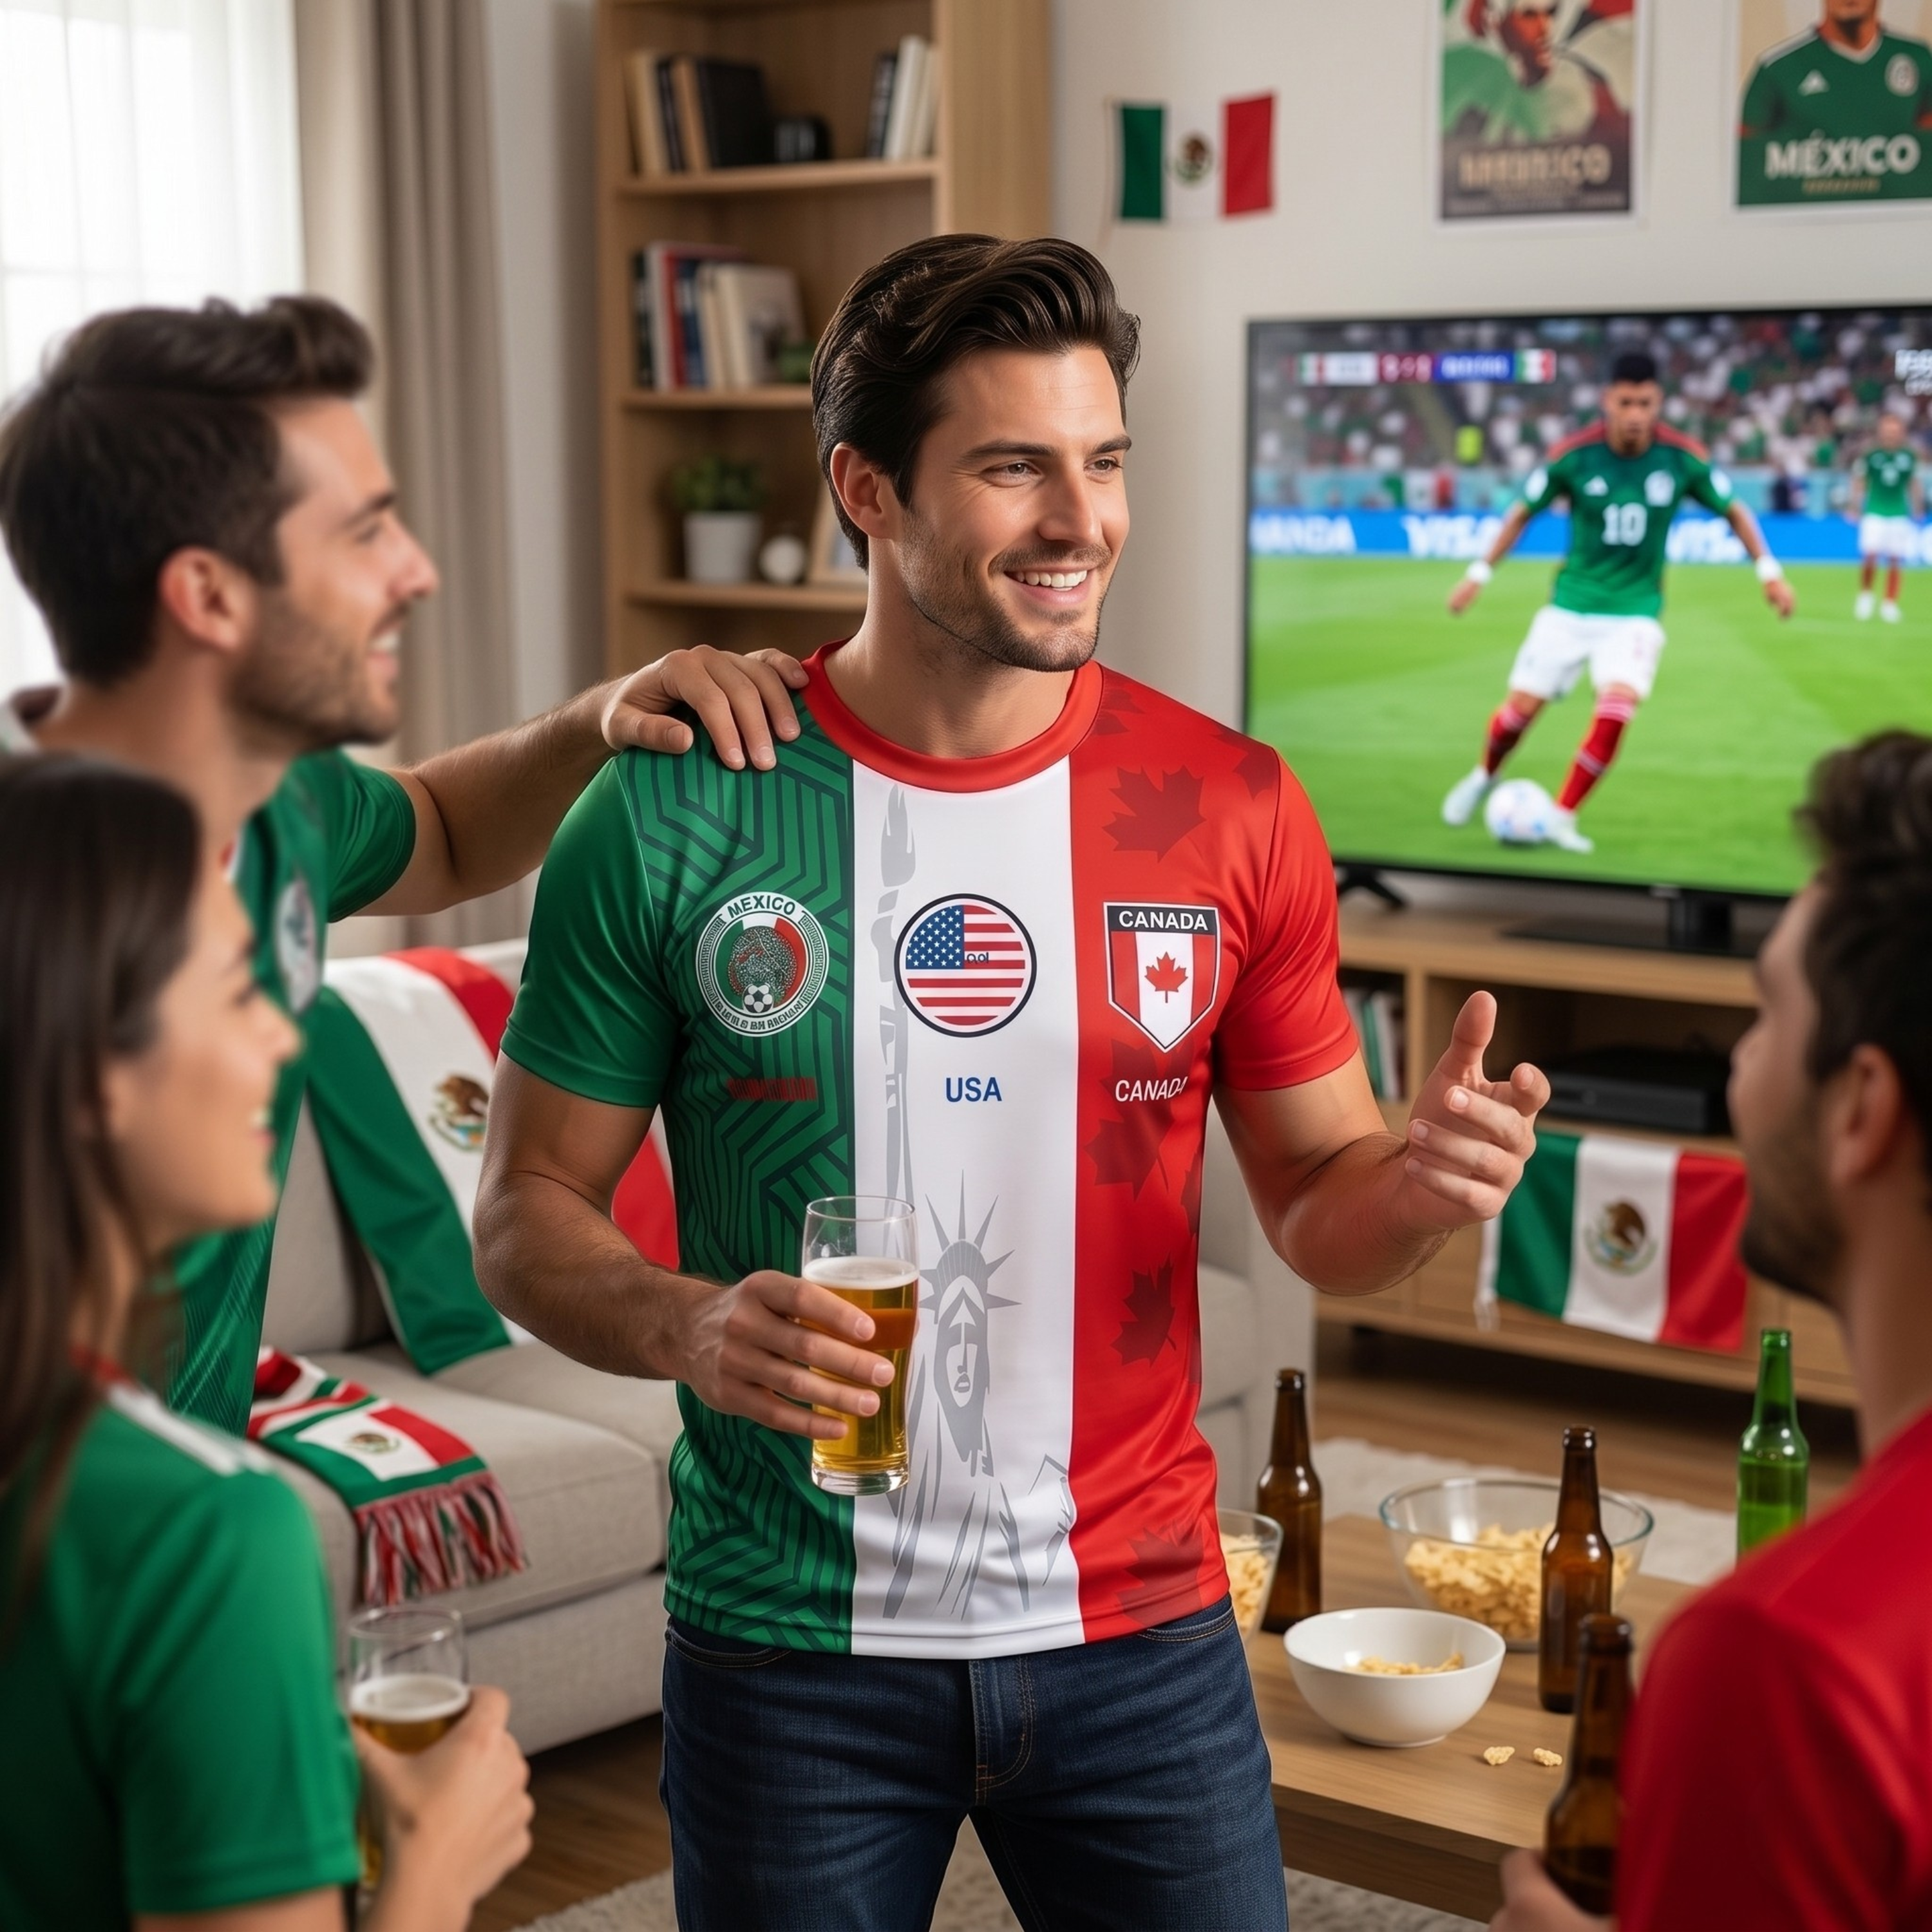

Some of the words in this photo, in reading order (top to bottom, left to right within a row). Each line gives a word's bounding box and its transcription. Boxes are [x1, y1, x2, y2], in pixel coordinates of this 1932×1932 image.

[1765, 128, 1921, 180] MÉXICO
[1601, 502, 1647, 545] 10
[727, 895, 796, 919] MEXICO
[1118, 910, 1209, 931] CANADA
[945, 1077, 1003, 1103] USA
